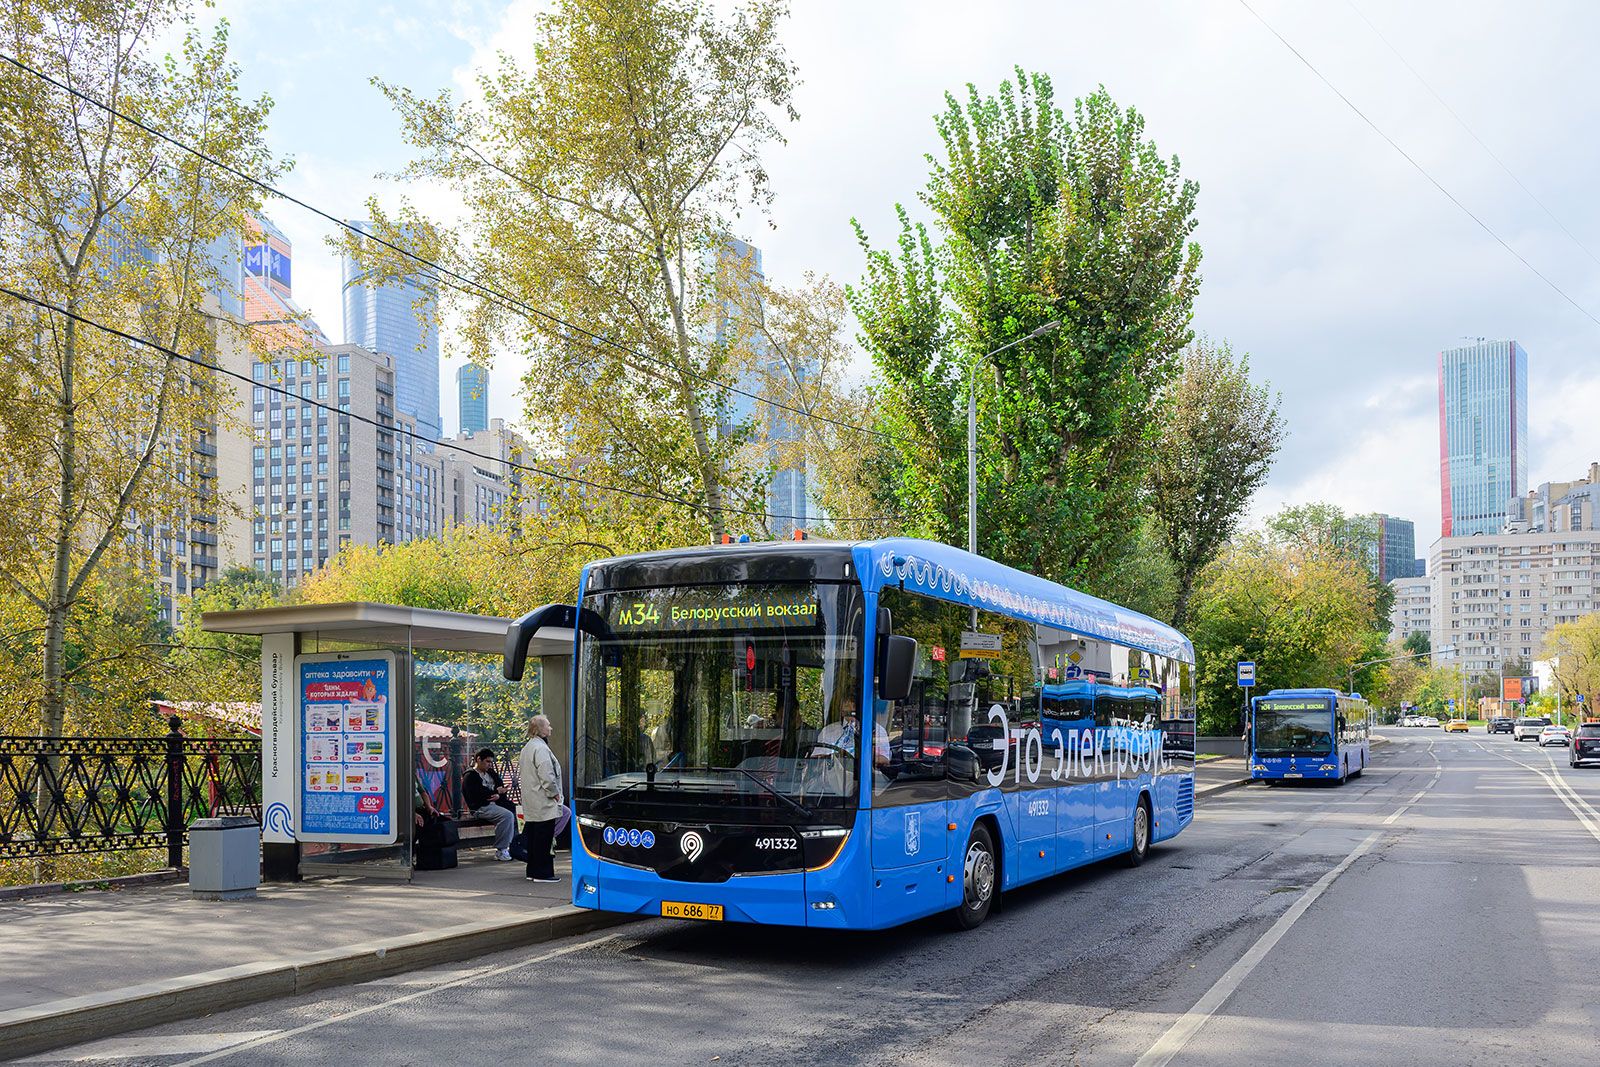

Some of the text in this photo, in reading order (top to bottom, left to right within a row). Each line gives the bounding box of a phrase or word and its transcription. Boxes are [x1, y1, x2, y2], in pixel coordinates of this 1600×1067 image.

[671, 602, 763, 623] Белорусский
[767, 602, 818, 618] вокзал
[304, 671, 330, 679] аптека
[271, 652, 279, 779] Красногвардейский бульвар
[987, 704, 1173, 789] Это электробус.
[362, 797, 380, 805] 500+
[1028, 800, 1050, 817] 491332
[368, 814, 386, 830] 18+
[754, 837, 798, 851] 491332
[666, 904, 720, 918] НО 686 77
